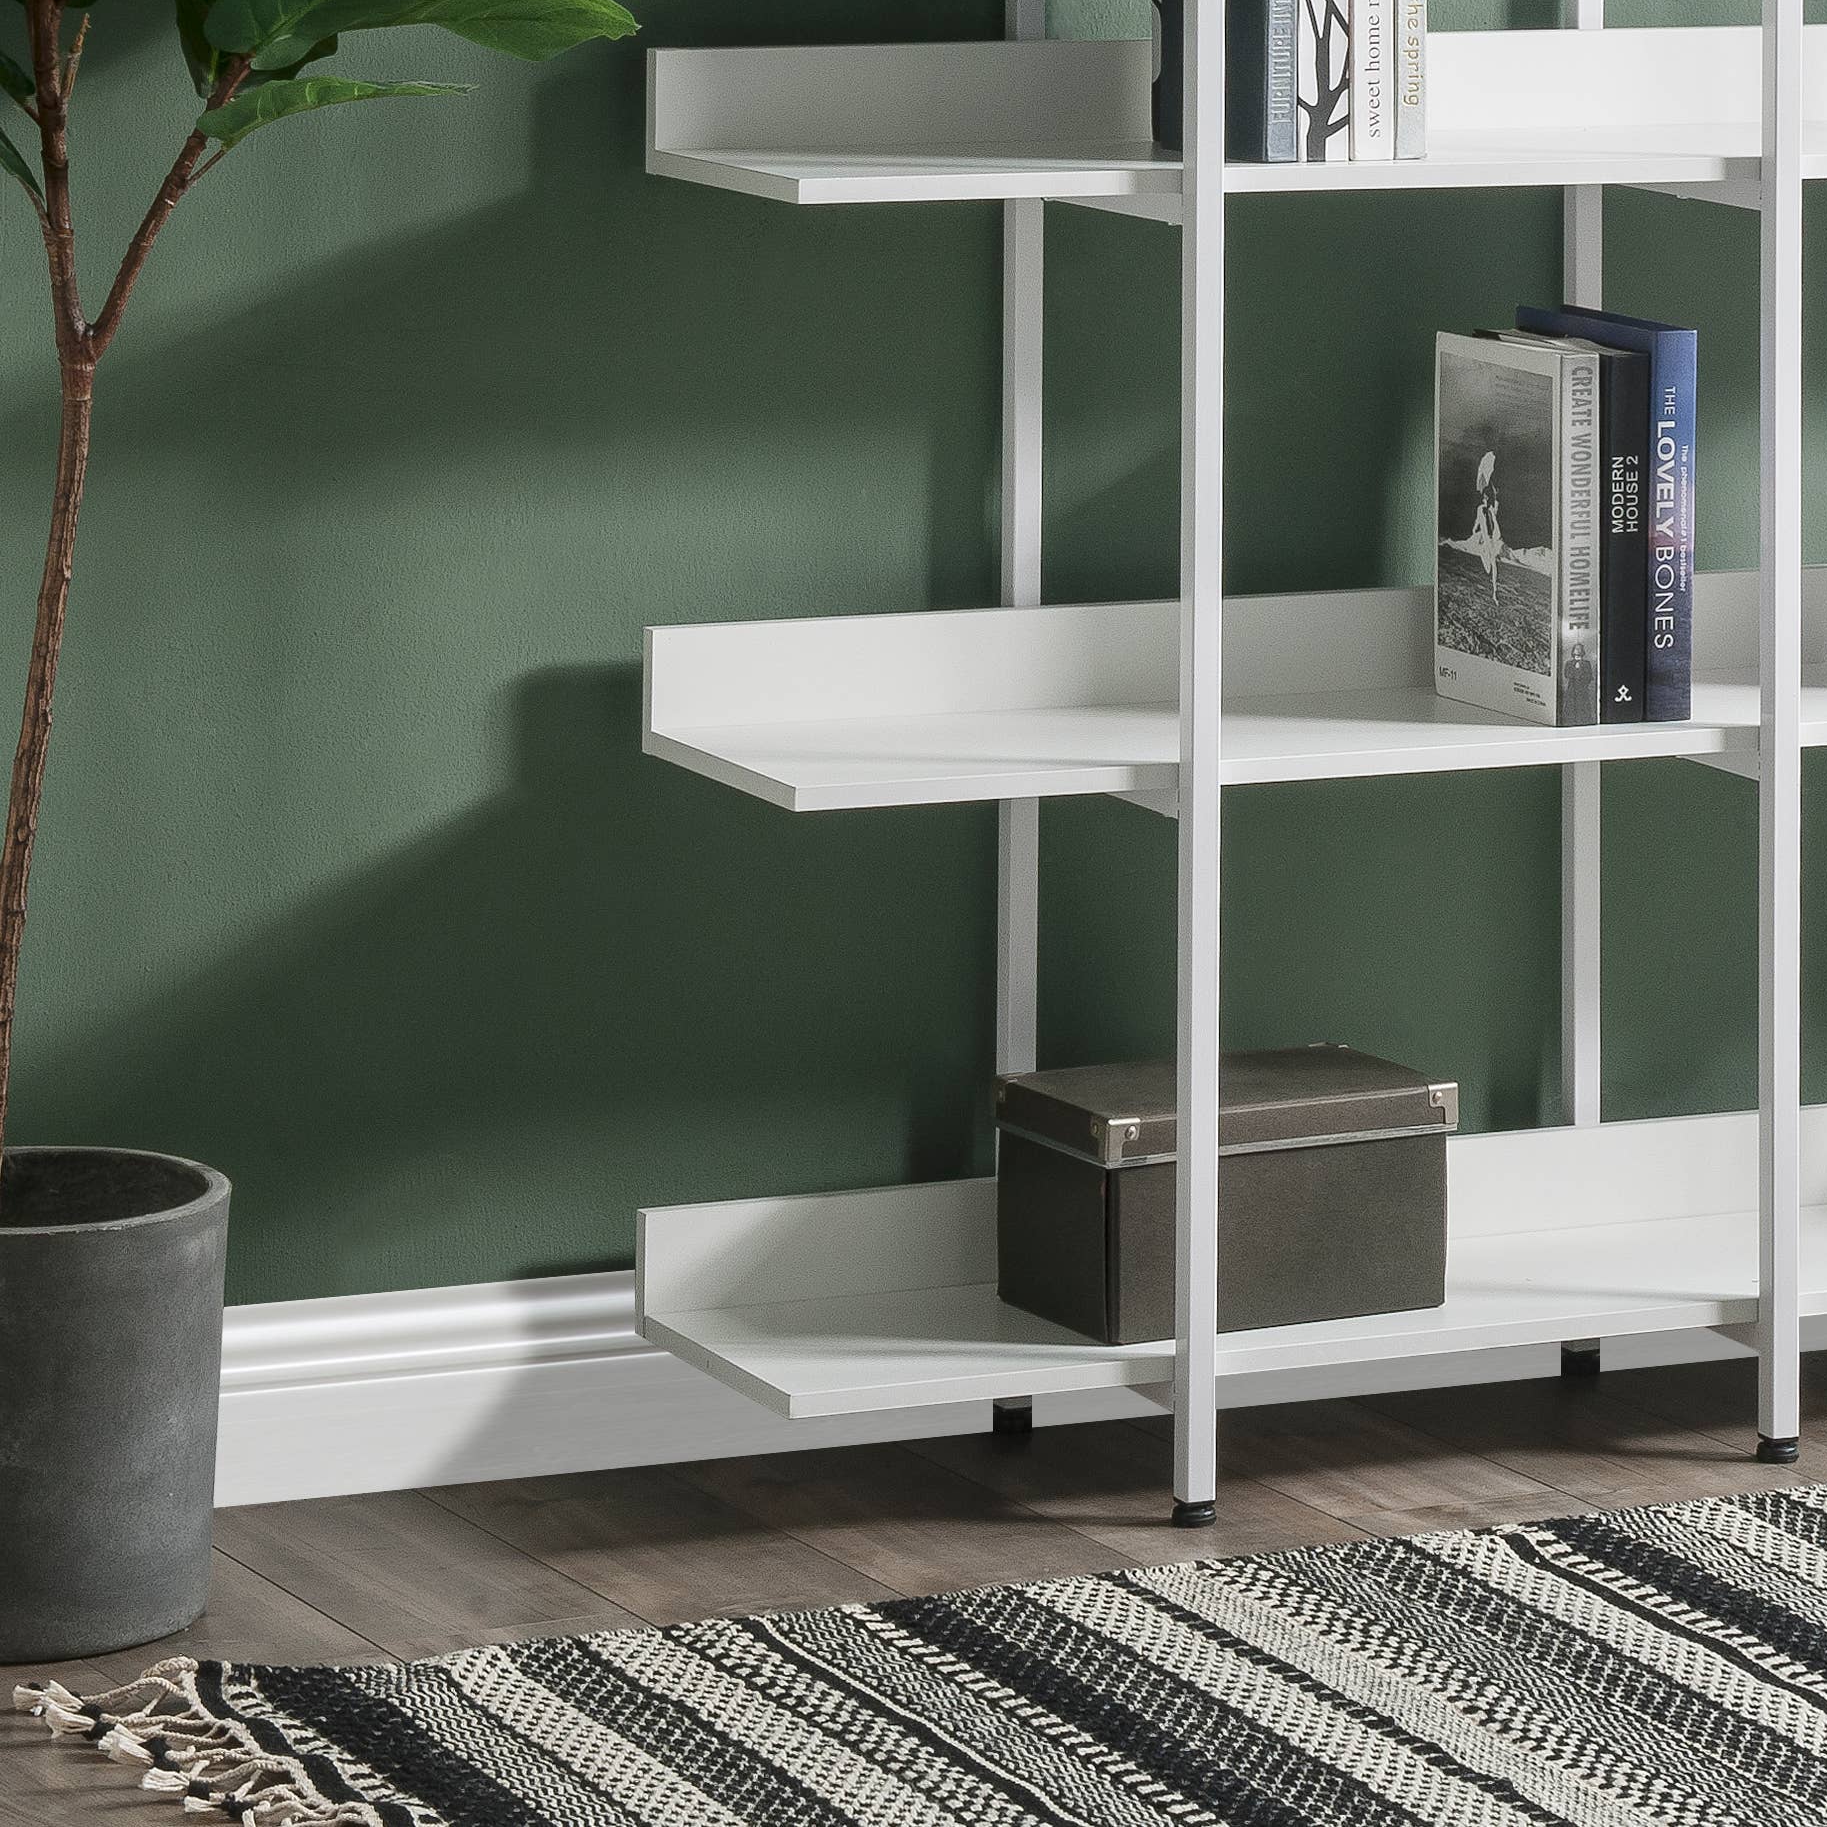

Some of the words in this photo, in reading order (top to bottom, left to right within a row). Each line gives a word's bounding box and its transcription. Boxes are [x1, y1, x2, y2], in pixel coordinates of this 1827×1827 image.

[1364, 15, 1381, 71] home
[1403, 36, 1424, 107] spring
[1367, 79, 1381, 138] sweet
[1571, 365, 1593, 426] CREATE
[1664, 386, 1676, 415] THE
[1570, 433, 1592, 539] WONDERFUL
[1626, 455, 1639, 464] 2
[1655, 420, 1676, 538] LOVELY
[1611, 456, 1624, 534] MODERN
[1626, 471, 1639, 532] HOUSE
[1569, 546, 1591, 630] HOMELIFE
[1654, 546, 1675, 649] BONES
